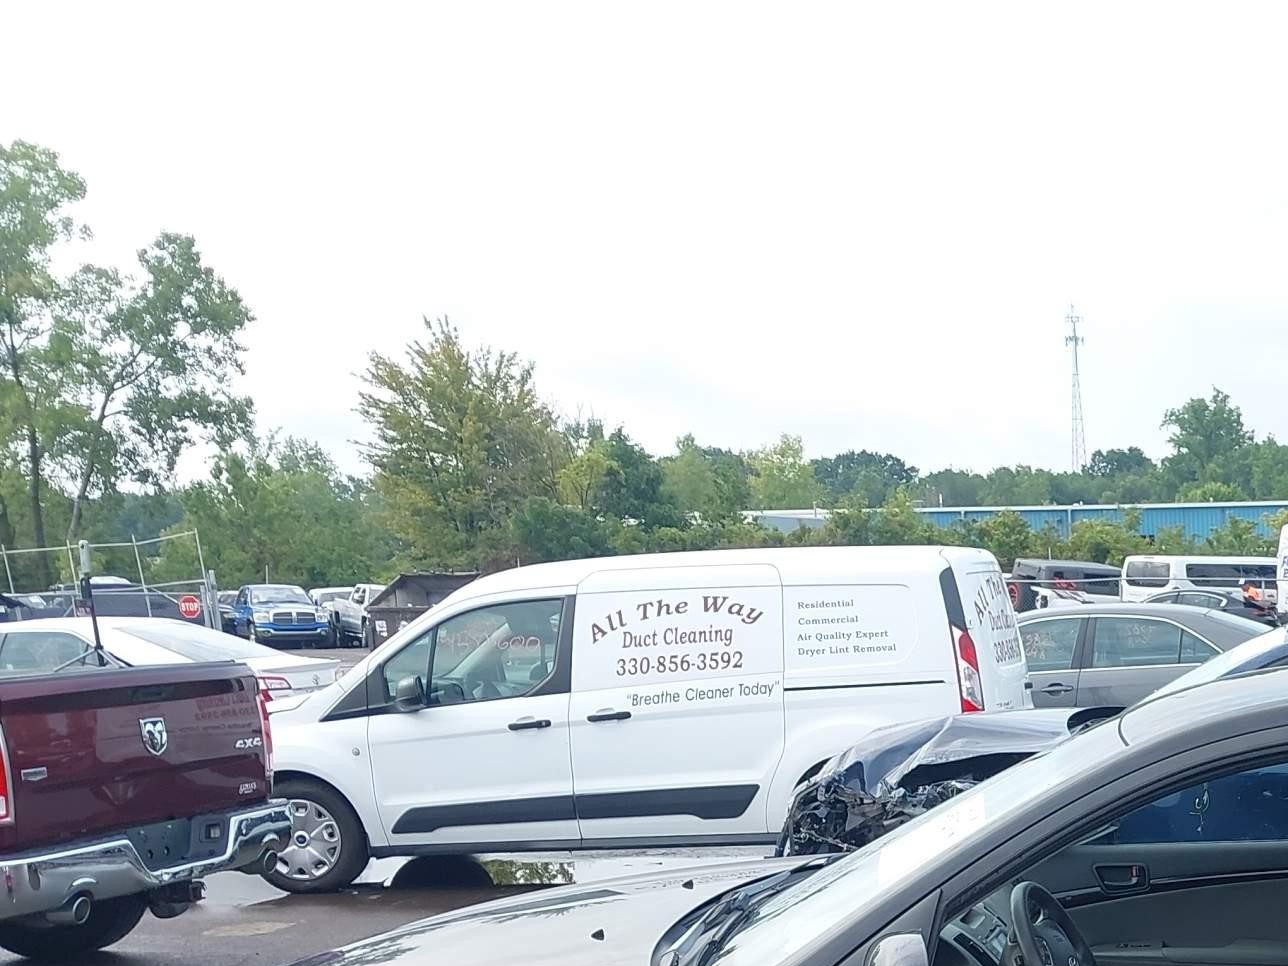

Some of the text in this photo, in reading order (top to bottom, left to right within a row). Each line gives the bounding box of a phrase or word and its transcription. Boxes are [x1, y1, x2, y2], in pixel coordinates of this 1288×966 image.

[181, 602, 198, 612] STOP
[797, 599, 854, 610] Residential
[591, 596, 764, 644] All The Way
[798, 615, 859, 626] Commercial
[622, 625, 733, 648] Duct Cleaning
[797, 630, 889, 642] Air Quality Expert
[798, 643, 897, 657] Dryer Lint Removal
[616, 651, 743, 676] 330-856-3592
[685, 687, 734, 702] Cleaner
